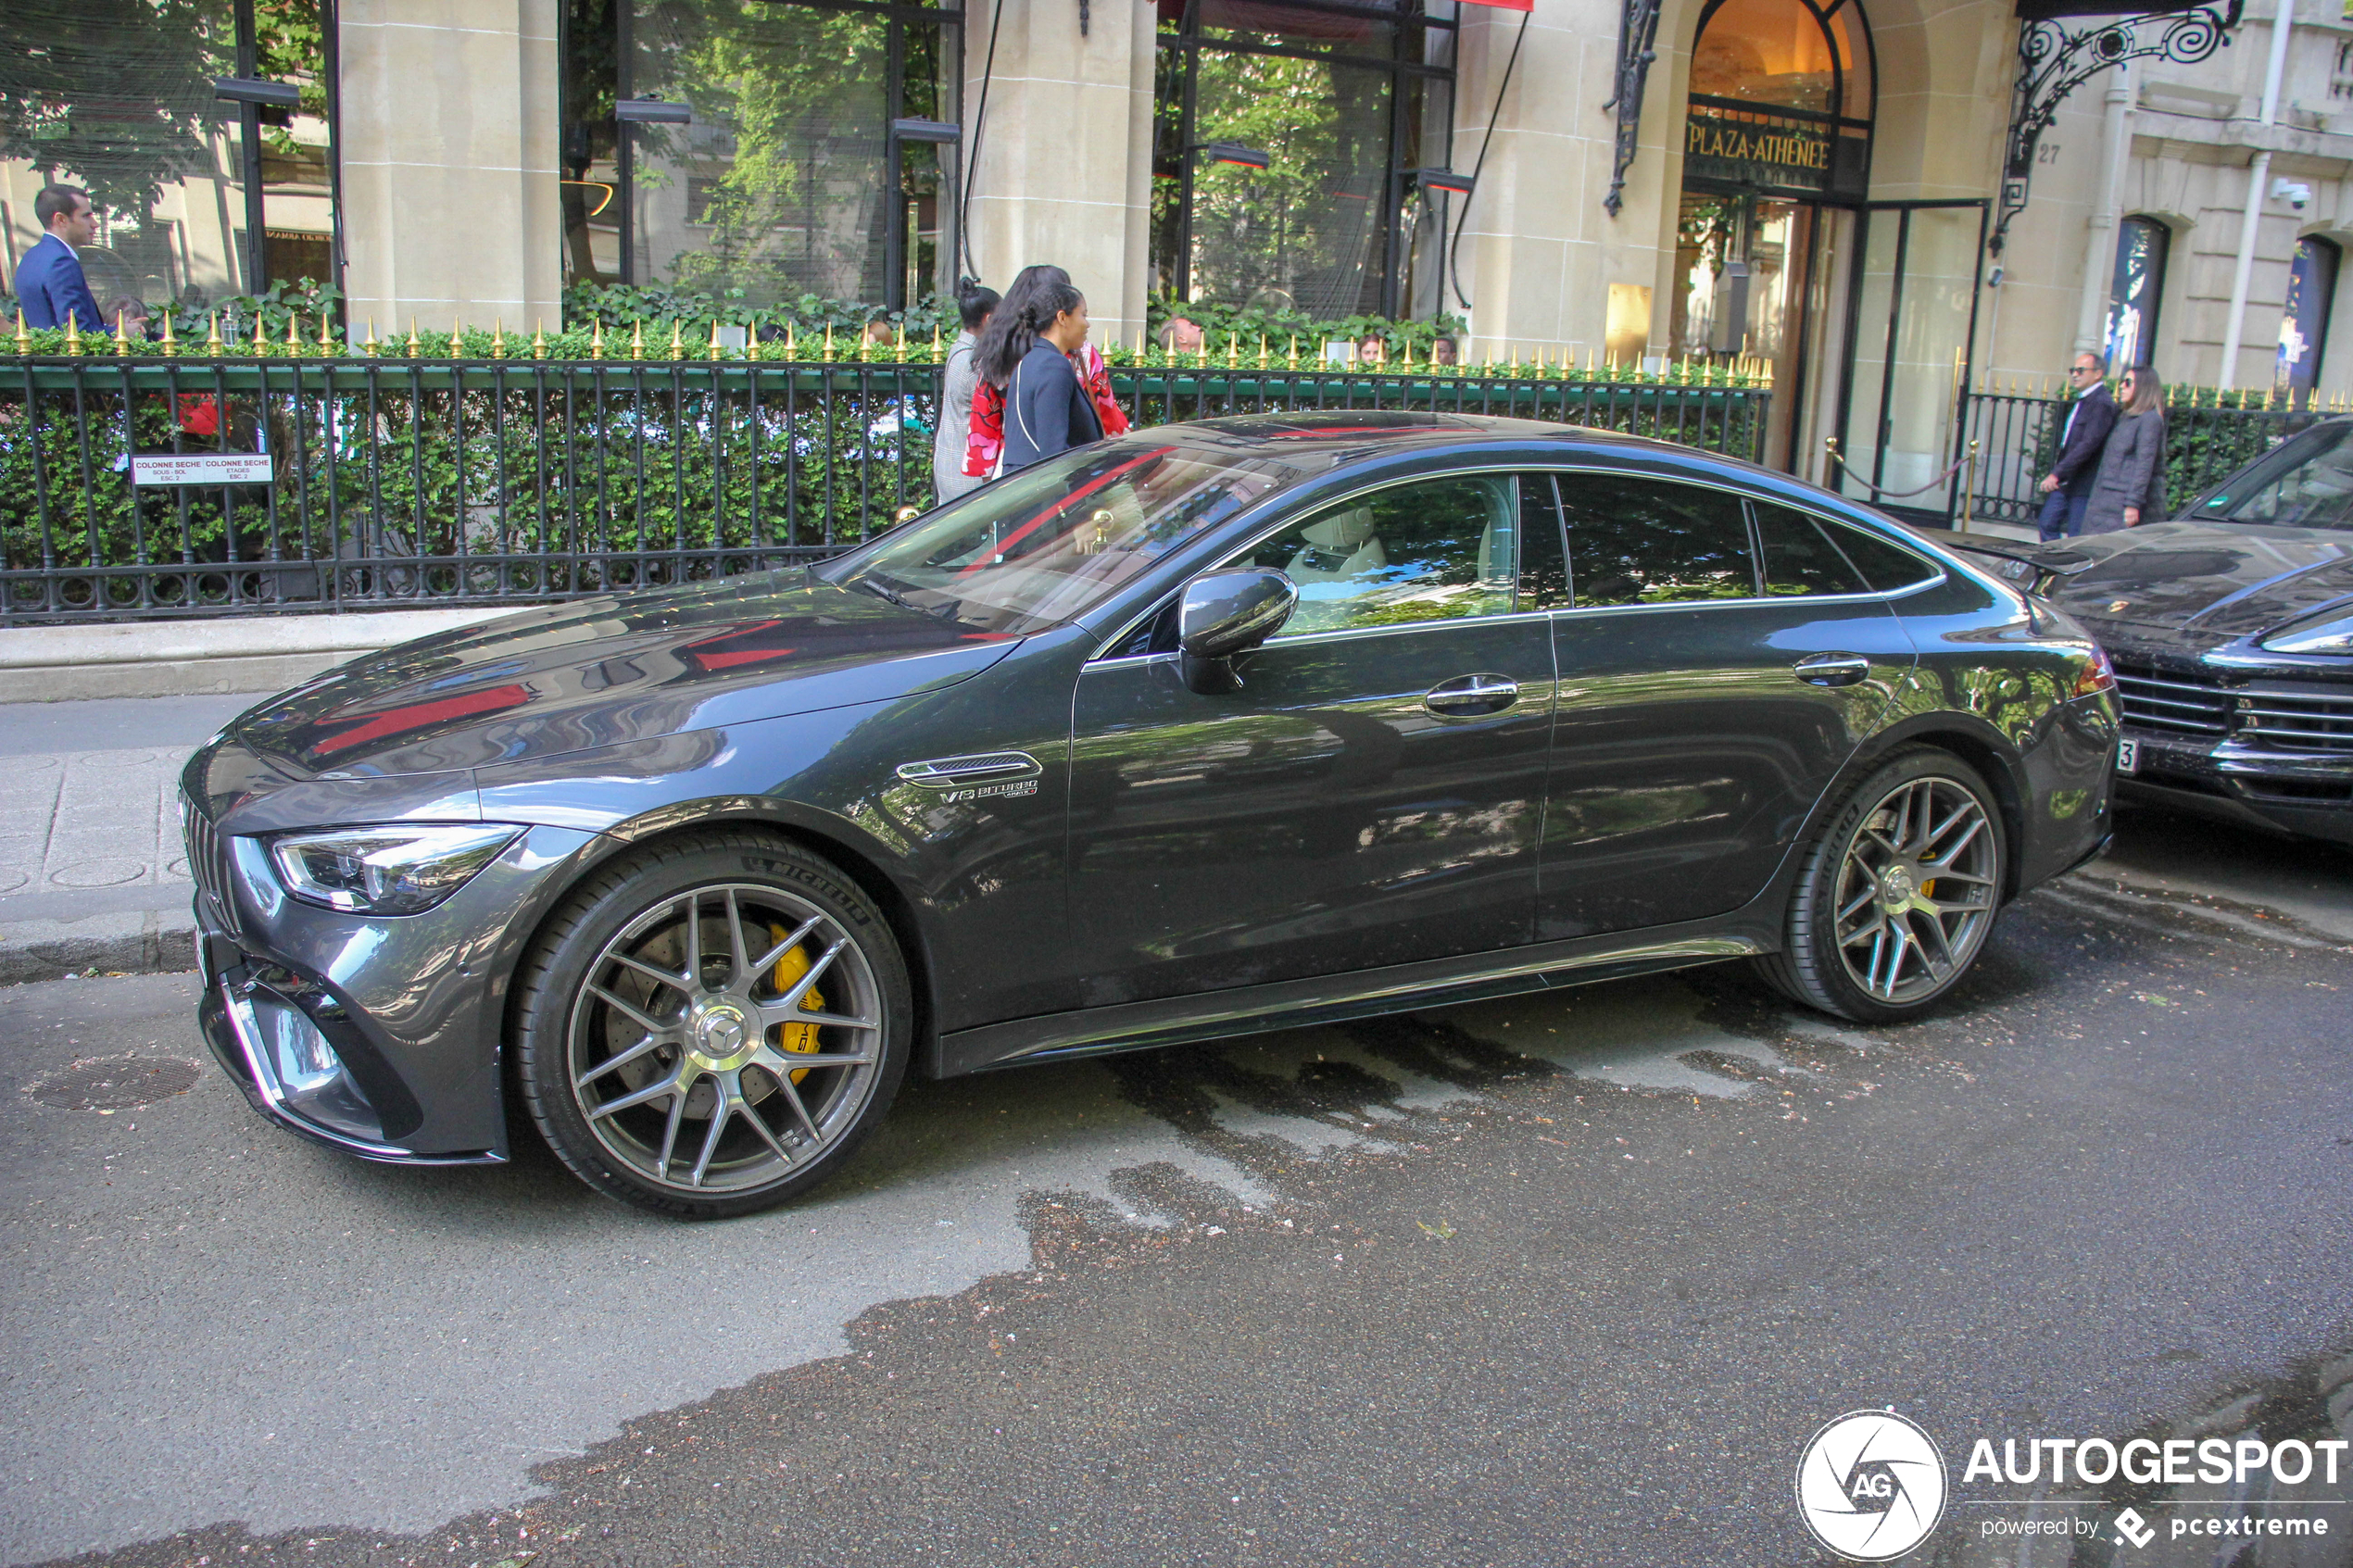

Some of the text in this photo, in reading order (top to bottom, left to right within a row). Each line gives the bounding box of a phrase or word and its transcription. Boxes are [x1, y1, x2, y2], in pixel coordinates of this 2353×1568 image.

[2039, 143, 2061, 164] 27
[2120, 743, 2133, 766] 3
[939, 780, 1038, 804] V8 BITURBO
[772, 862, 867, 922] MICHELIN
